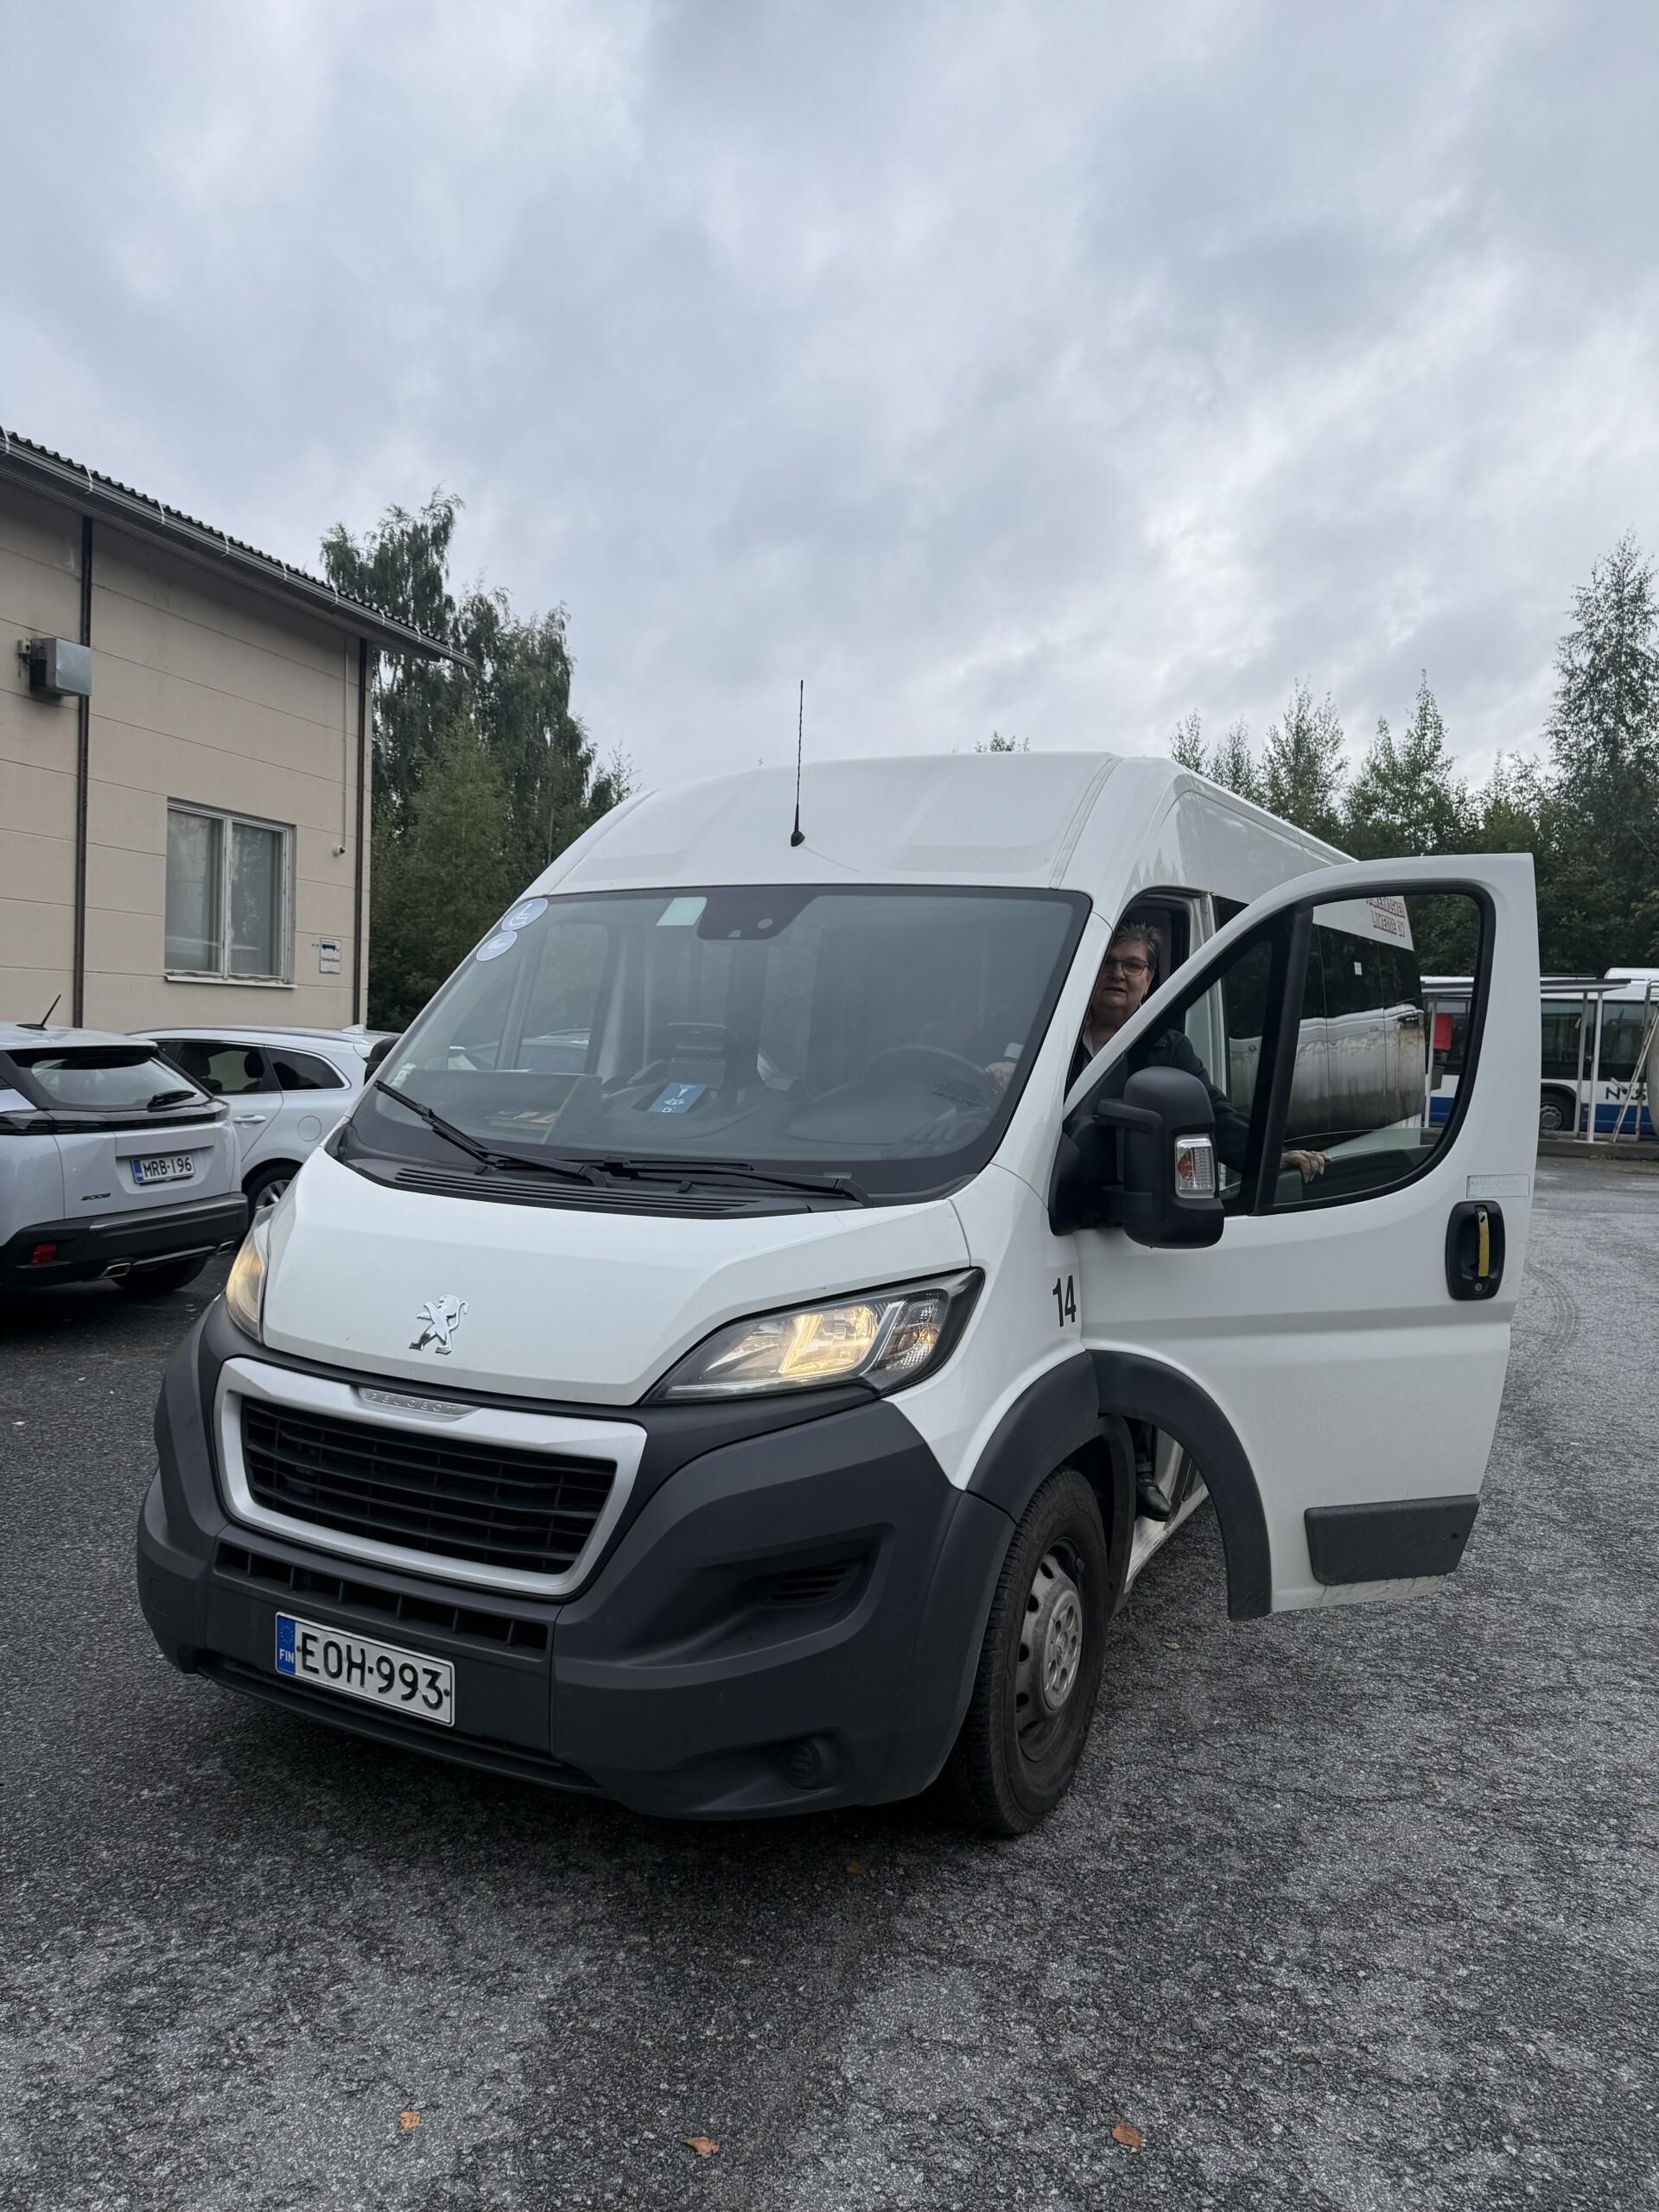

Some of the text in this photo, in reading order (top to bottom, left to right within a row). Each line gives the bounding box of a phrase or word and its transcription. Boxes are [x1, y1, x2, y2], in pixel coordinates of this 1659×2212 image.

[143, 1157, 192, 1178] MRB-196
[1052, 1274, 1077, 1327] 14
[279, 1649, 295, 1664] FIN
[301, 1630, 443, 1711] EOH-993
